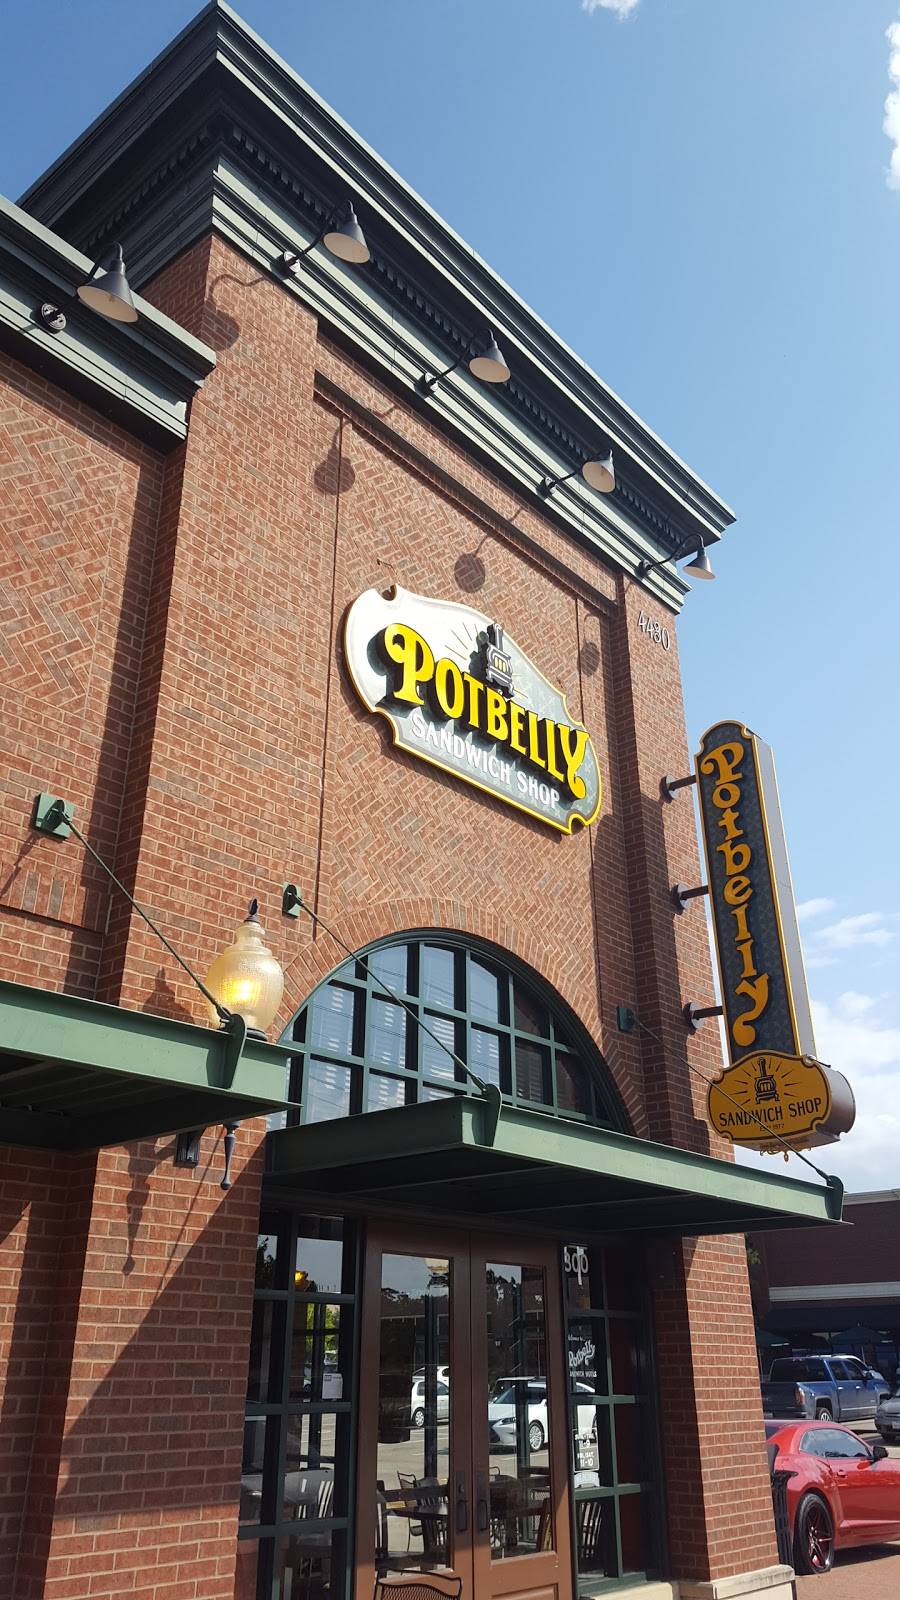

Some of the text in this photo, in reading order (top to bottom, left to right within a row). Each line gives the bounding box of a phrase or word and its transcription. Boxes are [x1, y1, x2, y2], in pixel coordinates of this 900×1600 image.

[638, 610, 670, 651] 4480
[383, 622, 590, 800] POTBELLY
[411, 712, 561, 809] SANDWICH SHOP
[700, 742, 770, 1047] Potbelly
[719, 1097, 822, 1127] SANDWICH SHOP
